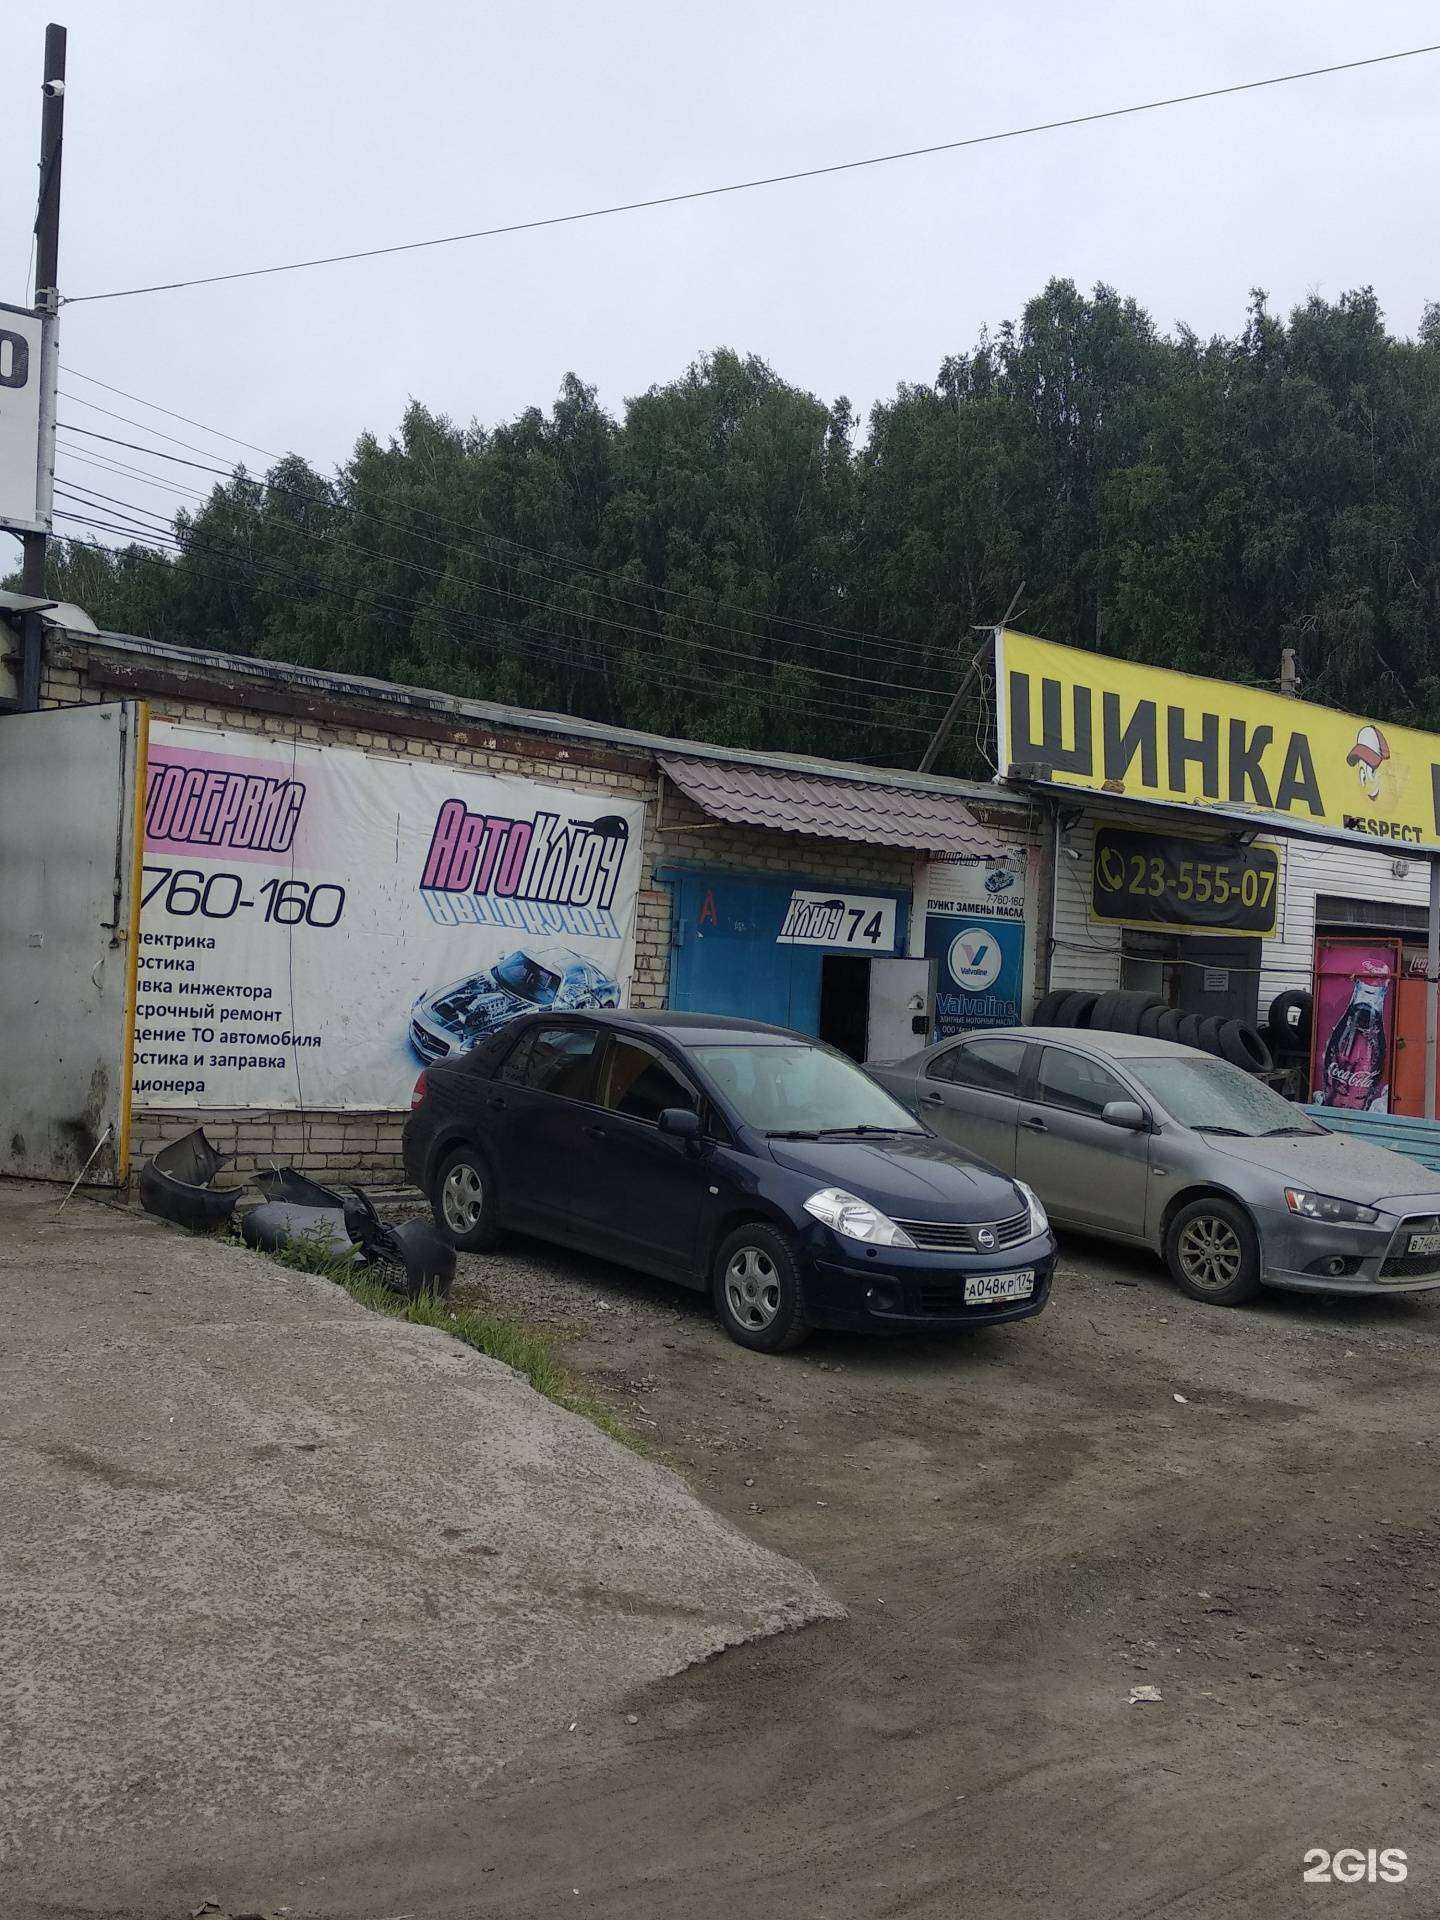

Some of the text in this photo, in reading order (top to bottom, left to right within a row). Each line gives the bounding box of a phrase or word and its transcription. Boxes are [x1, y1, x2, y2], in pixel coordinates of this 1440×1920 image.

[1009, 671, 1326, 817] ШИНКА
[1128, 855, 1276, 908] 23-555-07
[927, 899, 1025, 919] ПУНКТ ЗАМЕНЫ МАСЛА
[847, 909, 884, 944] 74
[178, 982, 273, 1002] инжектора
[136, 1003, 283, 1023] срочный ремонт
[936, 993, 1017, 1016] Valvoline
[191, 1027, 215, 1043] ТО
[219, 1030, 322, 1048] автомобиля
[193, 1054, 205, 1067] и
[209, 1055, 286, 1070] заправка
[968, 1279, 1015, 1297] А048КР
